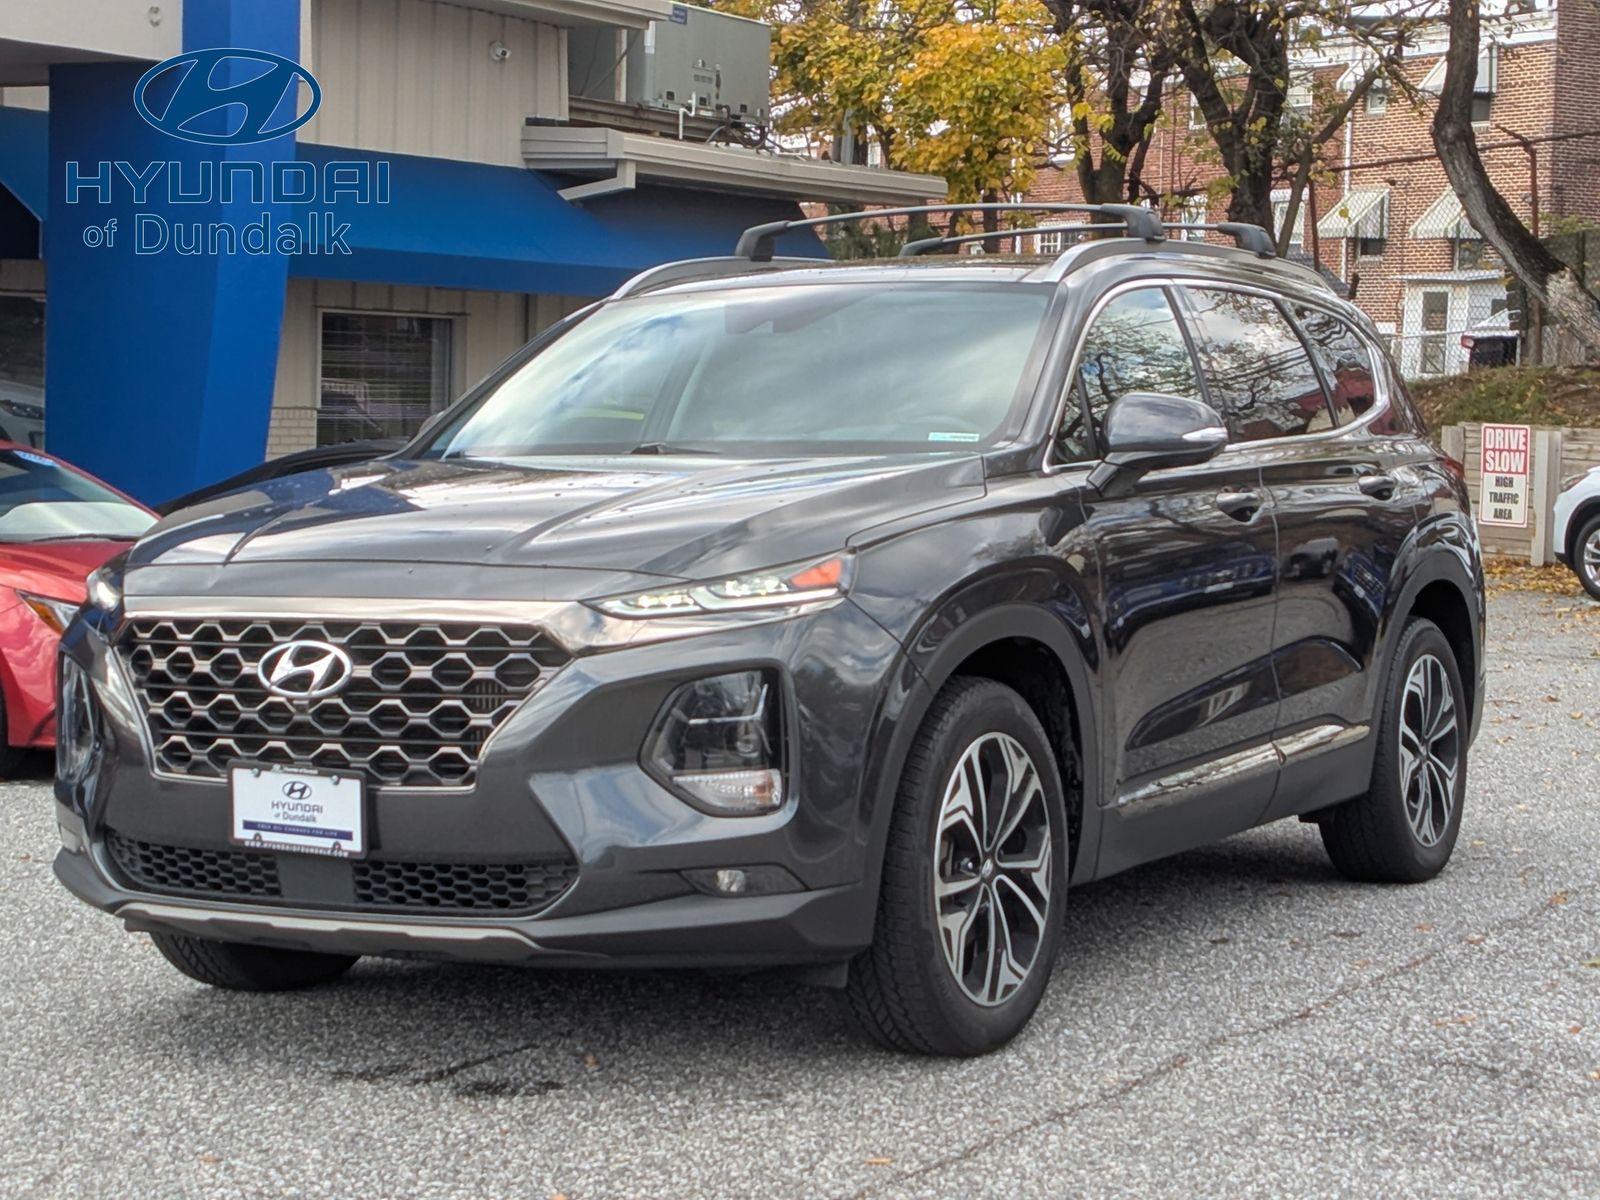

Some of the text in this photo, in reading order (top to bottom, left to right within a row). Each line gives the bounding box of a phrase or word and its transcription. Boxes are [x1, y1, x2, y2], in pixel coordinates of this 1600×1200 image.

[1485, 428, 1526, 450] DRIVE
[1485, 450, 1525, 473] SLOW
[1495, 476, 1514, 488] HIGH
[1489, 492, 1519, 504] TRAFFIC
[1493, 508, 1513, 520] AREA
[271, 801, 323, 814] HYUNDAI
[282, 811, 317, 822] Dundalk
